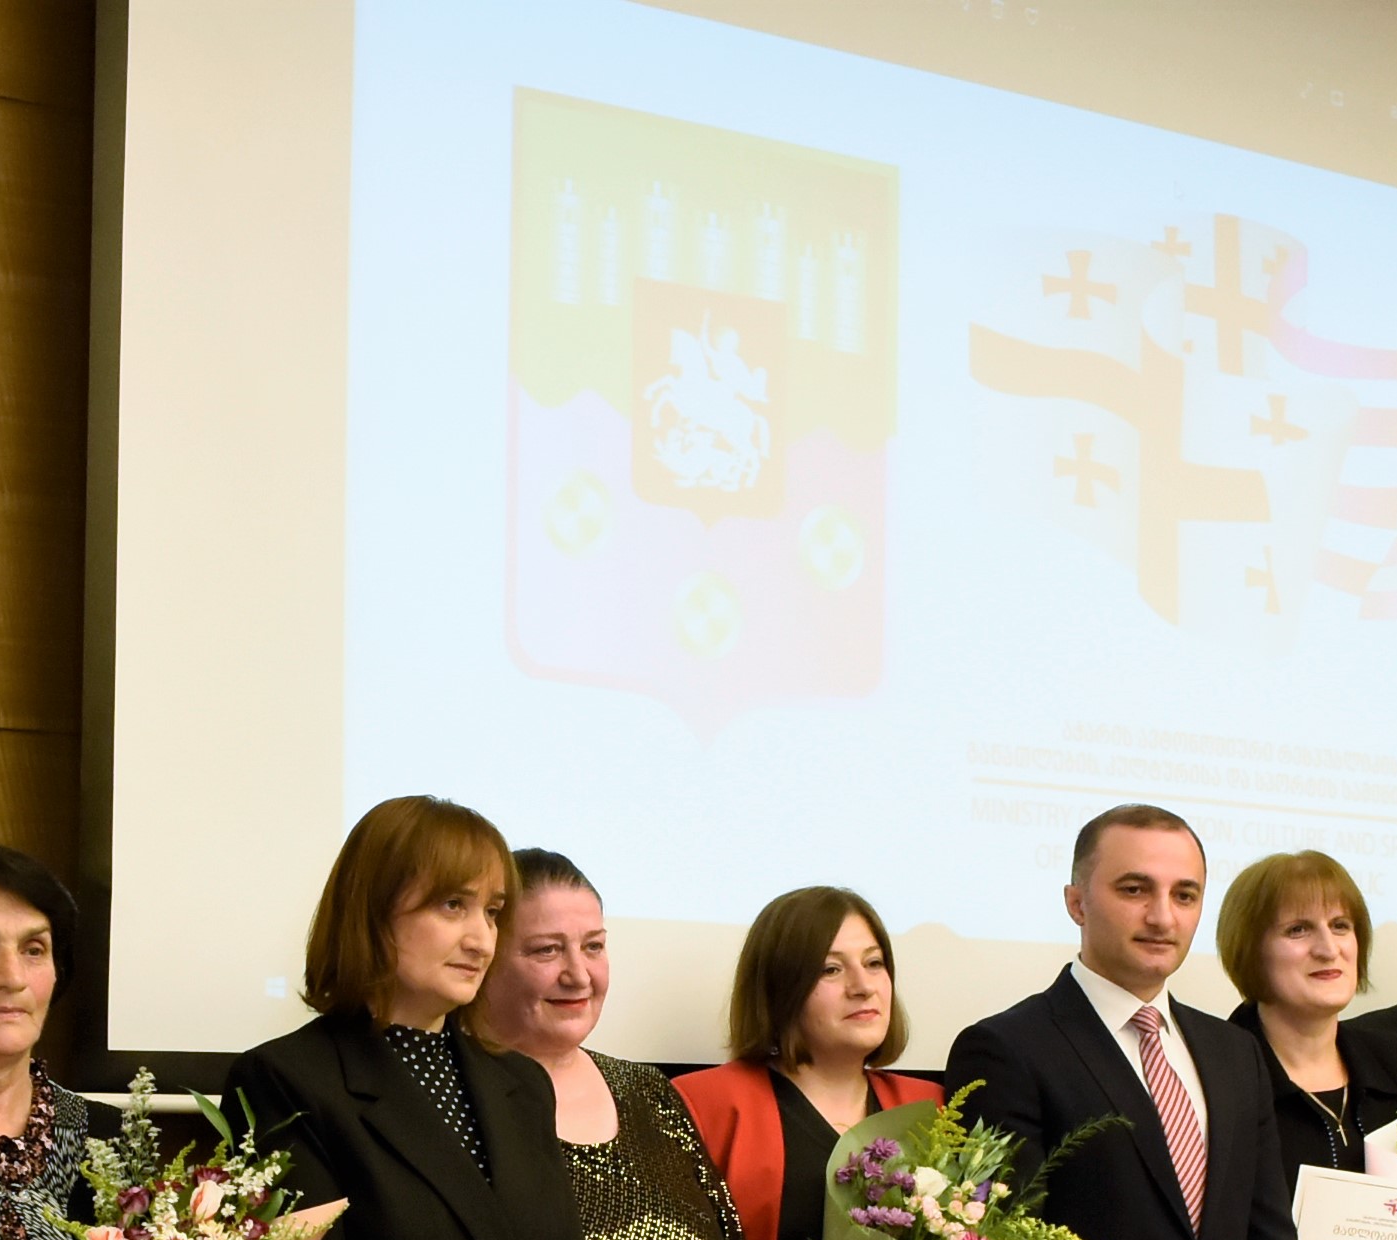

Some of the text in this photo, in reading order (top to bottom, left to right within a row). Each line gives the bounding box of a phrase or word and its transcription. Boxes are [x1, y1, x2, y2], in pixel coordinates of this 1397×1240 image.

[970, 797, 1072, 828] MINISTRY
[1242, 821, 1328, 852] CULTURE
[1333, 830, 1376, 856] AND
[1035, 843, 1065, 869] OF
